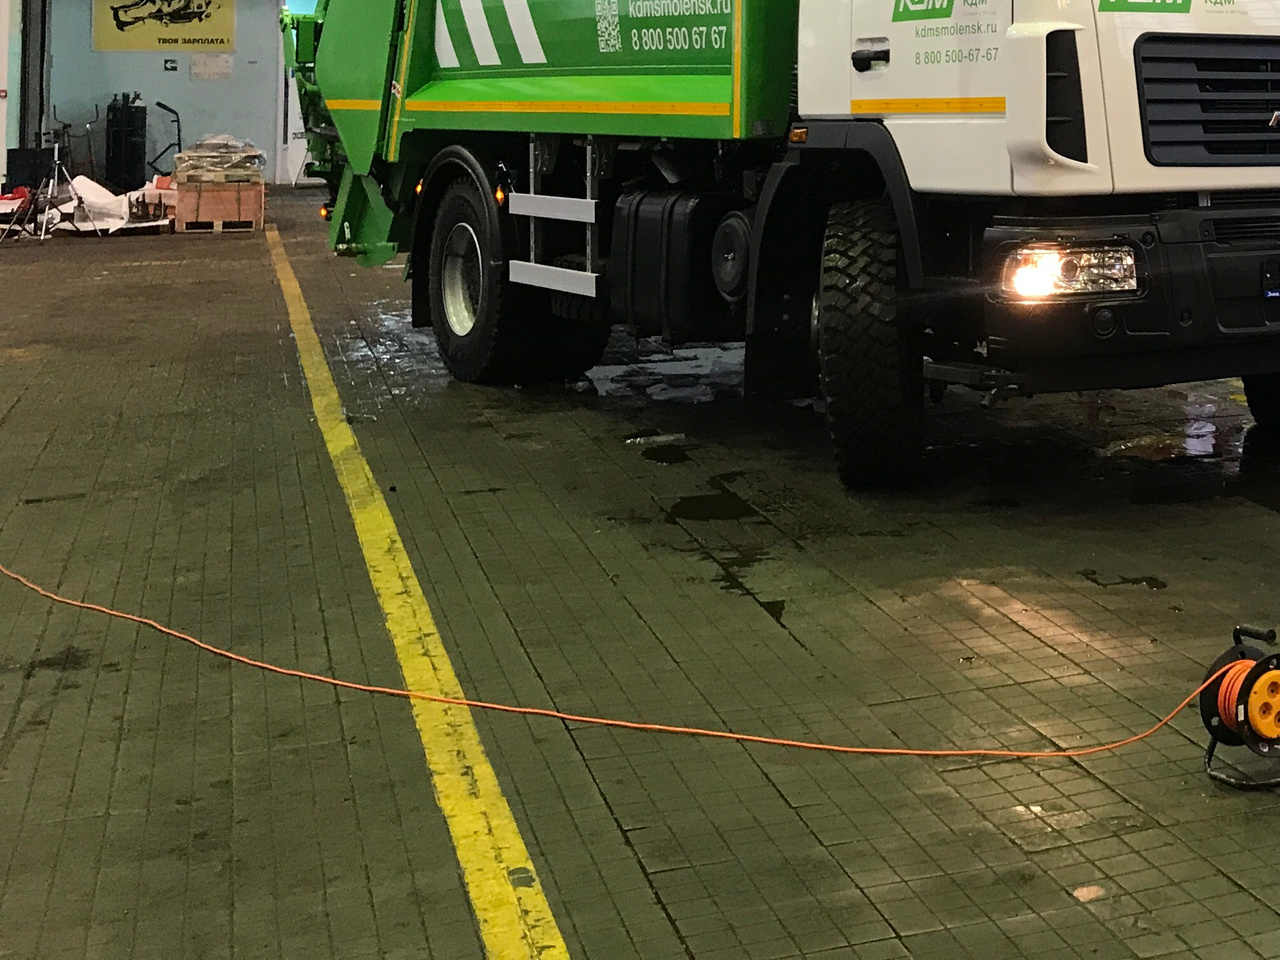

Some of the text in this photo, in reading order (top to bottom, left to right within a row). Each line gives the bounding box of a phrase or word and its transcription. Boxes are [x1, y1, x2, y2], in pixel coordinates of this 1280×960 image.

[631, 26, 727, 51] 8 800 500 67 67
[915, 21, 998, 39] kdmsmolensk.ru
[915, 47, 999, 66] 8 800 500-67-67
